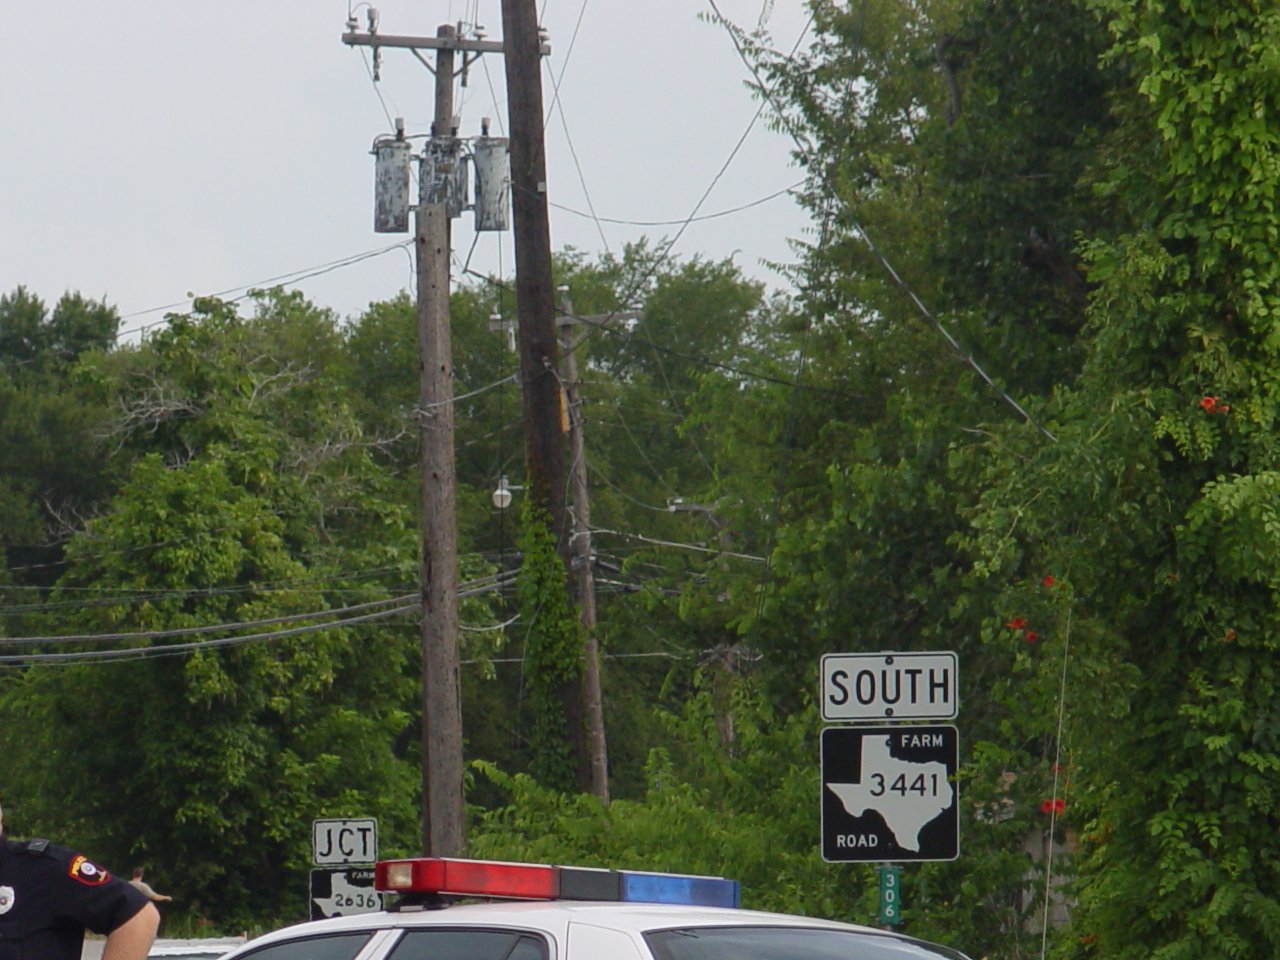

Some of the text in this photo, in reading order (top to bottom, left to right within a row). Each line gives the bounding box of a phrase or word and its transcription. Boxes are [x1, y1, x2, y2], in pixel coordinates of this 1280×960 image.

[829, 669, 949, 705] SOUTH
[901, 734, 943, 748] FARM
[870, 773, 938, 797] 3441
[319, 827, 372, 857] JCT
[837, 834, 878, 848] ROAD
[335, 893, 376, 908] 2636
[885, 874, 895, 917] 306
